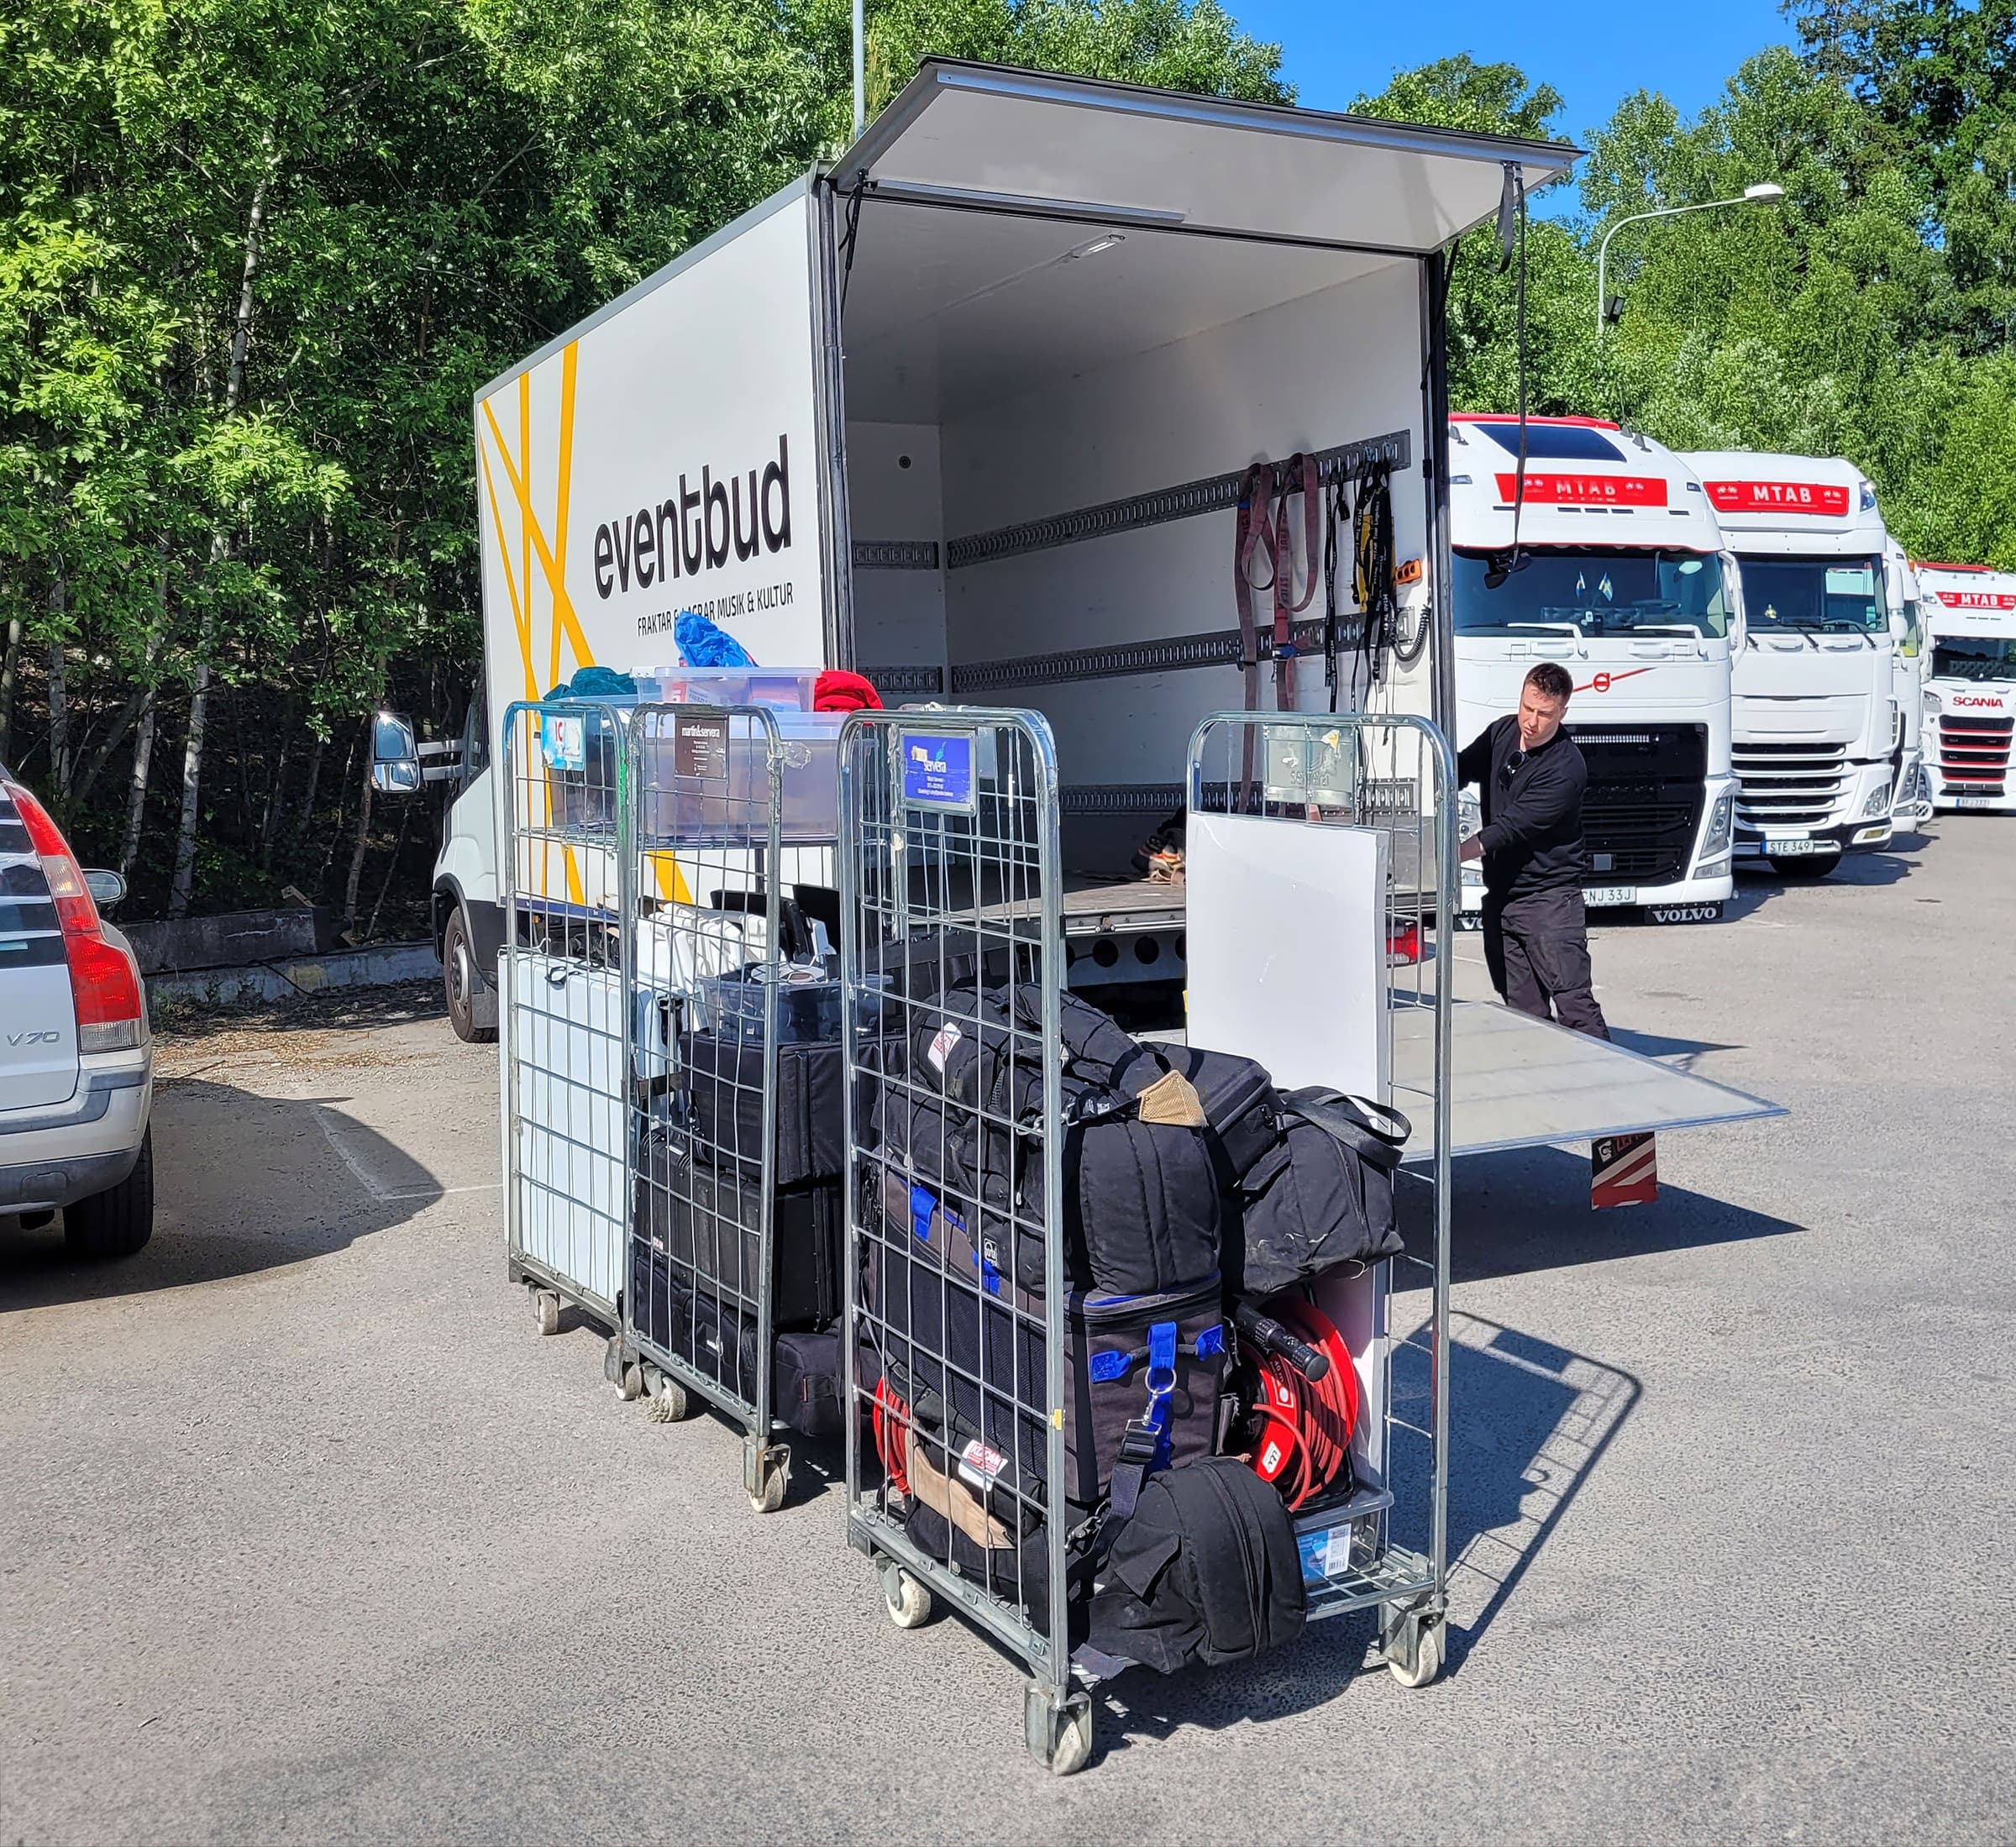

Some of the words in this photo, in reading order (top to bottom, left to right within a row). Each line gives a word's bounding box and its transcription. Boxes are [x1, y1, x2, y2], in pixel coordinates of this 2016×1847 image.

[1557, 480, 1616, 496] MTAB
[1753, 485, 1812, 503] MTAB
[594, 433, 791, 600] eventbud
[1961, 594, 1998, 606] MTAB
[638, 611, 672, 637] FRAKTAR
[681, 600, 715, 621] RAR
[717, 592, 745, 620] MUSIK
[747, 590, 754, 613] &
[757, 581, 794, 611] KULTUR
[1952, 695, 2003, 708] SCANIA
[1770, 842, 1788, 853] STE
[1791, 842, 1809, 852] 349
[1608, 889, 1631, 901] 33J
[1652, 906, 1717, 923] VOLVO
